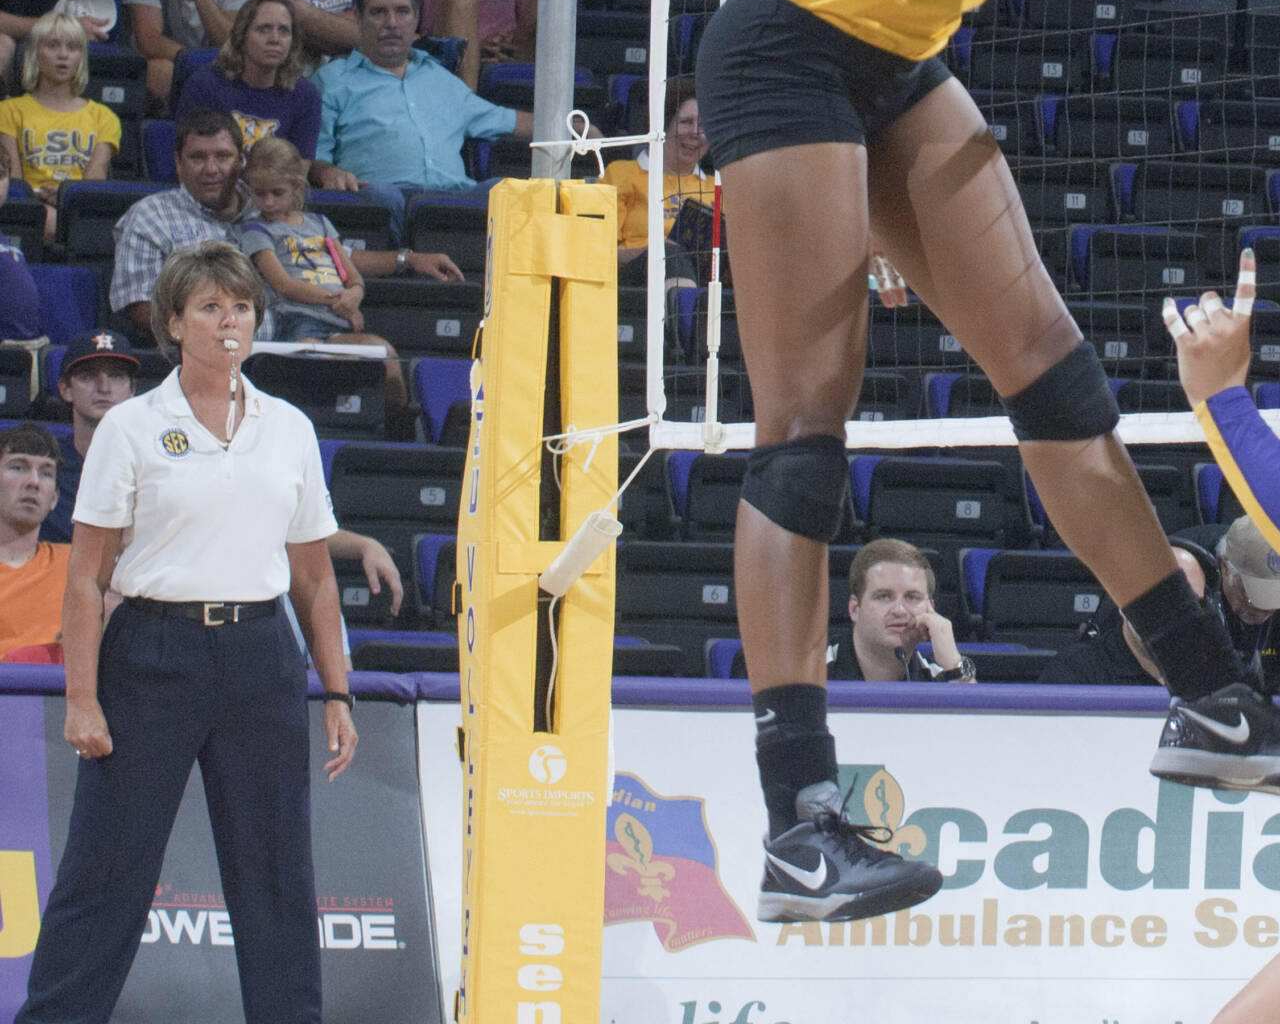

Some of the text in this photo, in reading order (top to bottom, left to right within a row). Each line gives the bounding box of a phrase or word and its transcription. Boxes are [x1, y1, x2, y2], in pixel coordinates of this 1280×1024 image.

[24, 128, 96, 157] LSU
[163, 432, 189, 454] SEC
[498, 787, 542, 801] SPORTS
[343, 896, 393, 907] SYSTEM
[775, 899, 1168, 948] Ambulance
